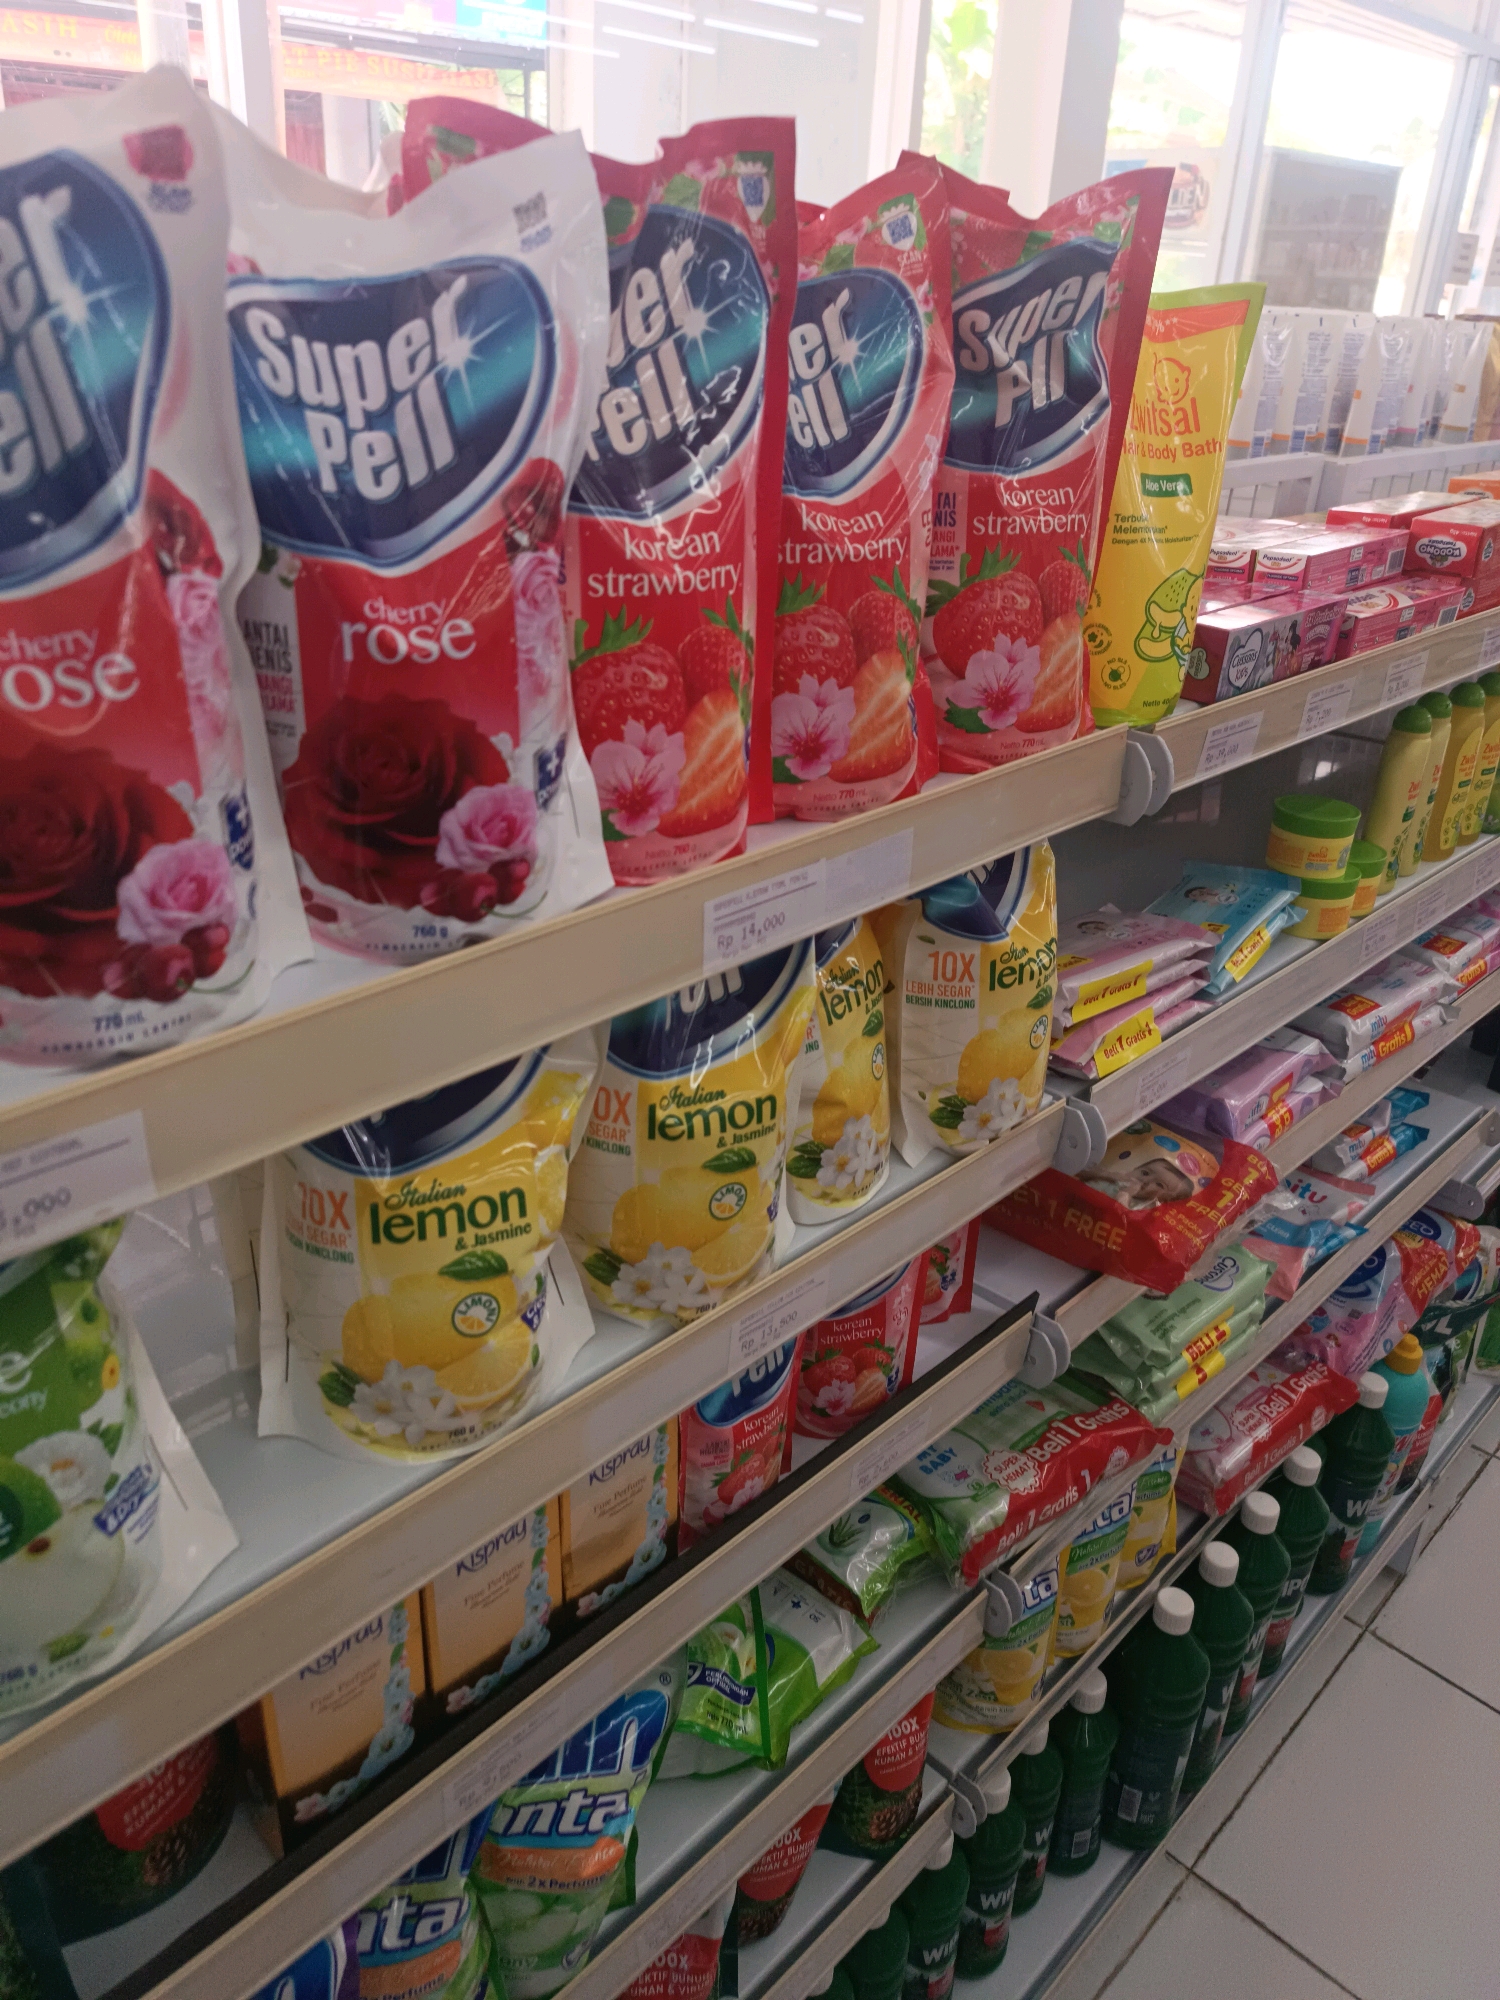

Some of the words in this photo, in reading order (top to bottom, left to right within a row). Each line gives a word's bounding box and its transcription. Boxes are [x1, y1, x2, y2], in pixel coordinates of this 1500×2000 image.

[788, 287, 850, 380] er
[958, 271, 1109, 372] Super
[245, 275, 469, 428] Super
[995, 332, 1066, 429] Pll
[788, 372, 848, 450] ell
[306, 372, 456, 500] Pell
[1148, 443, 1177, 463] Body
[1181, 438, 1223, 458] Bath
[1000, 482, 1074, 508] korean
[1161, 479, 1184, 492] Vera
[937, 491, 957, 510] TAI
[802, 503, 884, 536] korean
[934, 509, 957, 528] NIS
[972, 508, 1091, 539] strawberry
[624, 527, 721, 561] korean
[933, 530, 956, 543] ANGI
[1419, 542, 1462, 558] KODOMO
[588, 563, 741, 600] strawberry
[363, 596, 447, 627] cherry
[244, 619, 289, 650] ANTAI
[341, 618, 477, 664] rose
[1, 652, 140, 712] ose
[716, 934, 734, 949] Rp
[741, 912, 786, 941] 14,000
[928, 950, 977, 984] 10X
[988, 936, 1058, 993] lemon
[819, 959, 884, 1027] lemon
[905, 980, 935, 997] LEBIH
[905, 993, 933, 1008] BERSIH
[934, 998, 976, 1011] KINCLONG
[1103, 1041, 1119, 1061] Beli
[1125, 1030, 1148, 1048] Gratis
[1378, 1031, 1406, 1058] Gratis
[1403, 1021, 1413, 1041] 1
[593, 1085, 633, 1127] 0X
[659, 1084, 727, 1113] Italian
[647, 1093, 778, 1142] lemon
[585, 1138, 632, 1157] KINCLONG
[716, 1137, 728, 1150] &
[729, 1122, 777, 1147] Jasmine
[1246, 1153, 1272, 1181] BUY
[1365, 1144, 1390, 1169] Gratis
[1221, 1177, 1250, 1201] GET
[1243, 1167, 1260, 1186] 1
[297, 1181, 350, 1231] 10X
[383, 1177, 467, 1211] Italian
[1216, 1190, 1235, 1208] 1
[1285, 1178, 1329, 1205] itu
[0, 1186, 72, 1233] ,000
[369, 1186, 528, 1246] lemon
[1013, 1184, 1042, 1208] ET
[1062, 1207, 1128, 1253] FREE
[1185, 1200, 1228, 1229] FREE
[454, 1236, 468, 1251] &
[470, 1222, 532, 1249] Jasmine
[819, 1324, 884, 1346] strawberry
[832, 1315, 873, 1333] korean
[1272, 1383, 1298, 1401] 1
[1289, 1362, 1329, 1393] Gratis
[743, 1405, 779, 1434] korean
[1259, 1392, 1291, 1419] Beli
[1026, 1430, 1072, 1463] Beli
[1051, 1421, 1082, 1438] 1
[1074, 1402, 1130, 1431] Gratis
[918, 1446, 958, 1476] BABY
[1269, 1434, 1297, 1463] Gratis
[993, 1455, 1021, 1474] SUPER
[1002, 1462, 1033, 1484] HEMAT
[613, 1475, 649, 1499] Perfume
[996, 1521, 1024, 1553] Beli
[1027, 1509, 1036, 1530] 1
[1038, 1484, 1079, 1522] Gratis
[1080, 1468, 1091, 1493] 1
[874, 1751, 906, 1766] KUMAN
[876, 1738, 908, 1757] EFEKTIF
[491, 1788, 629, 1837] nta
[770, 1826, 802, 1852] 00X
[752, 1861, 781, 1874] UMAN
[980, 1890, 1013, 1911] WI
[650, 1951, 689, 1971] 00X
[922, 1943, 956, 1966] WI
[631, 1983, 664, 1997] UMAN
